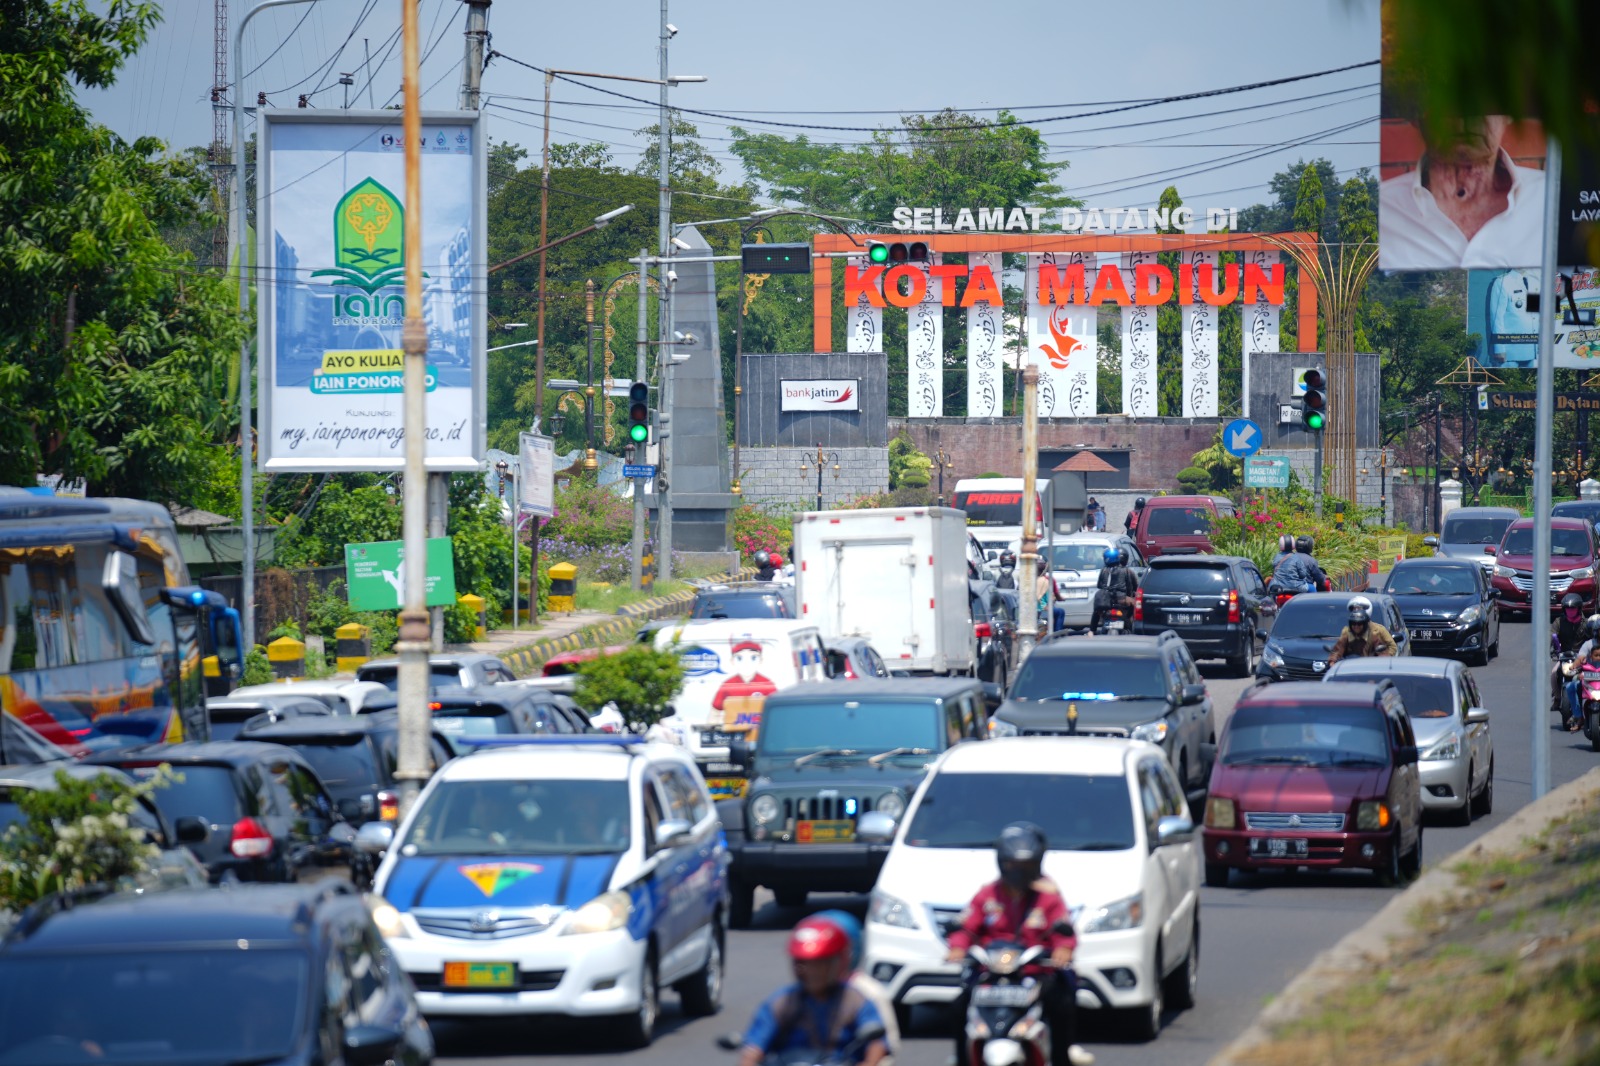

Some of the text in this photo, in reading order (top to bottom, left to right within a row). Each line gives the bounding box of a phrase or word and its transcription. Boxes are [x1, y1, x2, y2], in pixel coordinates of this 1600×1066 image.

[1579, 190, 1600, 204] SA
[892, 206, 1238, 231] SELAMAT DATANG DI
[844, 263, 1285, 308] KOTA MADIUN
[326, 355, 355, 368] AYO
[314, 374, 435, 389] IAIN PONORO
[786, 387, 839, 399] bankjatim
[1492, 393, 1539, 409] Selama
